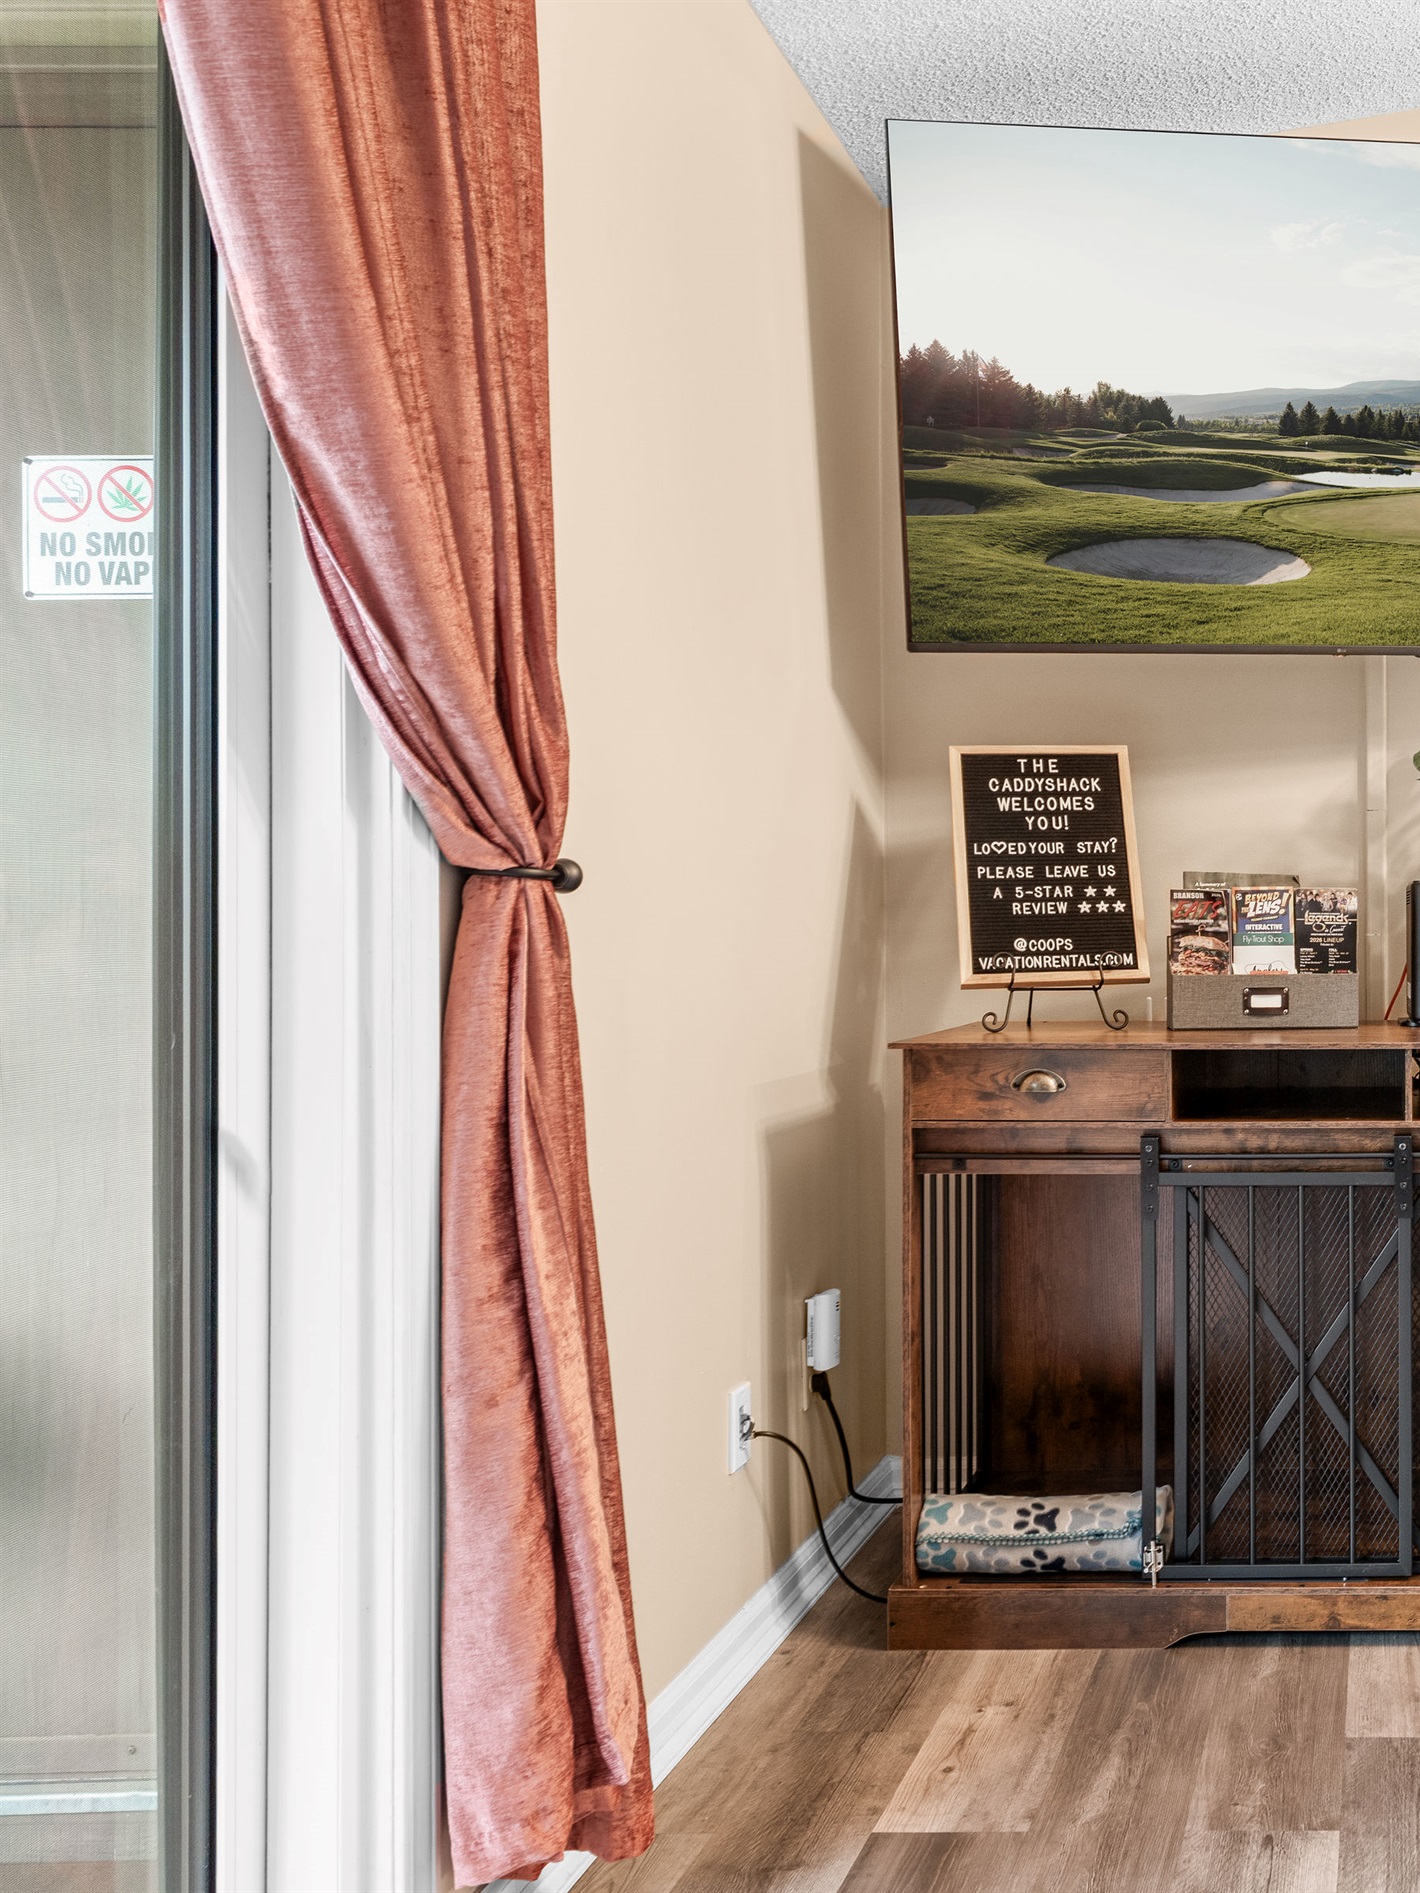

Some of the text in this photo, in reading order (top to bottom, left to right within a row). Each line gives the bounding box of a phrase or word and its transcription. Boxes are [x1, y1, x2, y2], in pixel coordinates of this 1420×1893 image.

[40, 532, 76, 556] NO
[55, 561, 154, 586] NO VAP
[1017, 758, 1059, 773] THE
[988, 777, 1101, 792] CADDYSHACK
[997, 796, 1095, 812] WELCOMES
[1025, 815, 1069, 830] YOU!
[1028, 842, 1064, 854] YOUR
[1077, 837, 1118, 854] STAY?
[977, 864, 1116, 879] PLEASE LEAVE US
[993, 885, 1074, 899] A 5-STAR
[1245, 892, 1279, 904] BEYOND
[1012, 902, 1068, 915] REVIEW
[1173, 900, 1222, 919] EATS
[1013, 937, 1074, 952] @COOPS
[1268, 935, 1284, 944] Shop
[978, 953, 1134, 970] VACATIONRENTALS.COM
